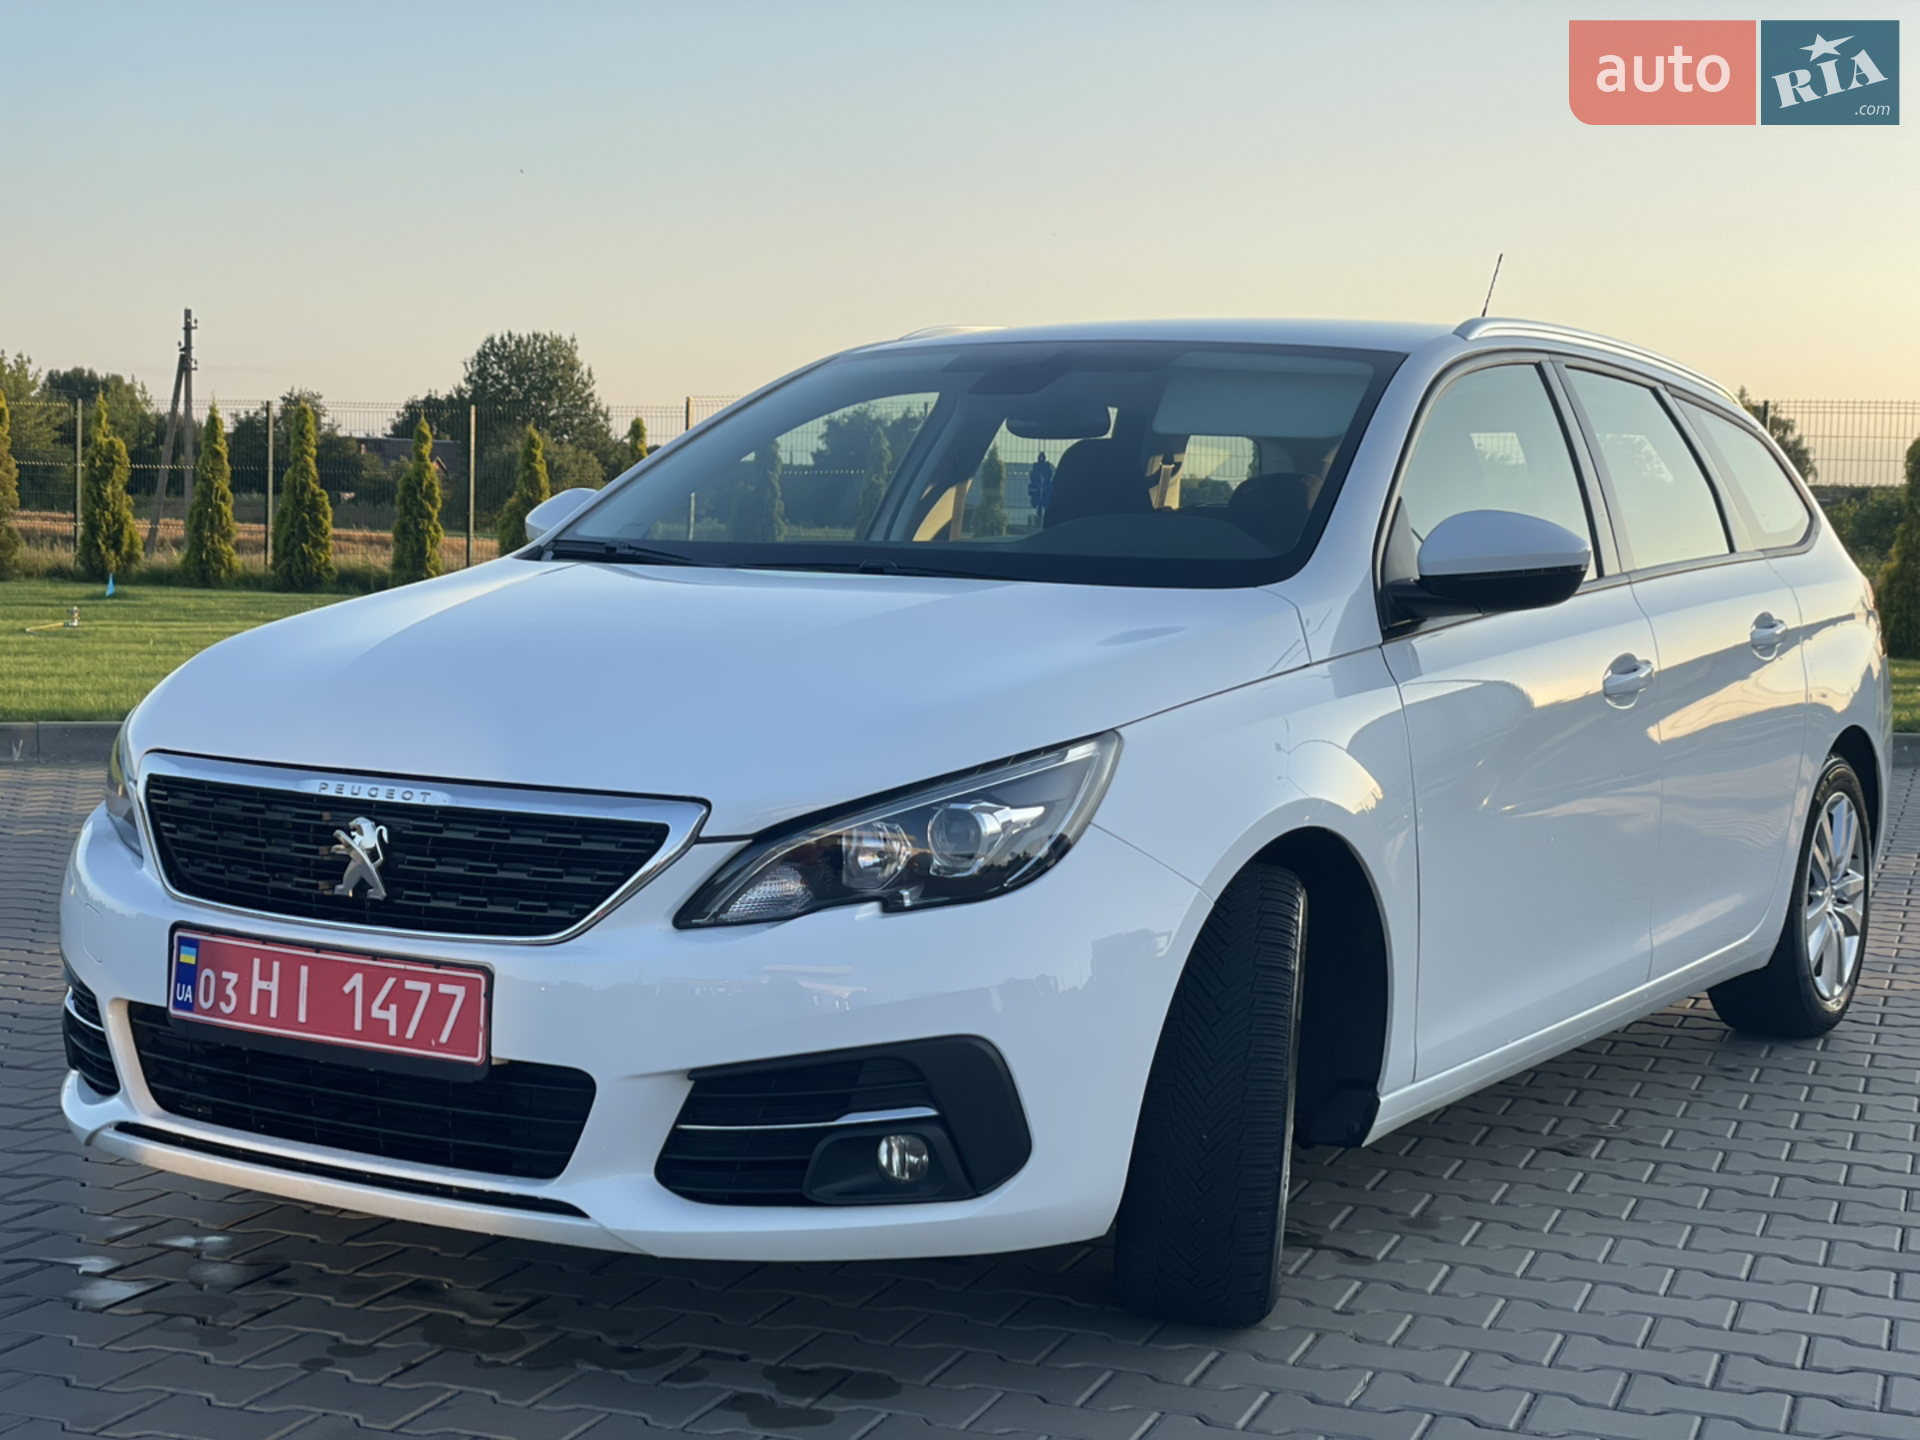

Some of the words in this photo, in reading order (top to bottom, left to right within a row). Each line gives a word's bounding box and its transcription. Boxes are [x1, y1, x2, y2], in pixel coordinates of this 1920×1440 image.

[318, 782, 432, 803] PEUGEOT
[176, 982, 193, 1003] UA
[199, 968, 239, 1014] 03
[342, 972, 466, 1044] 1477
